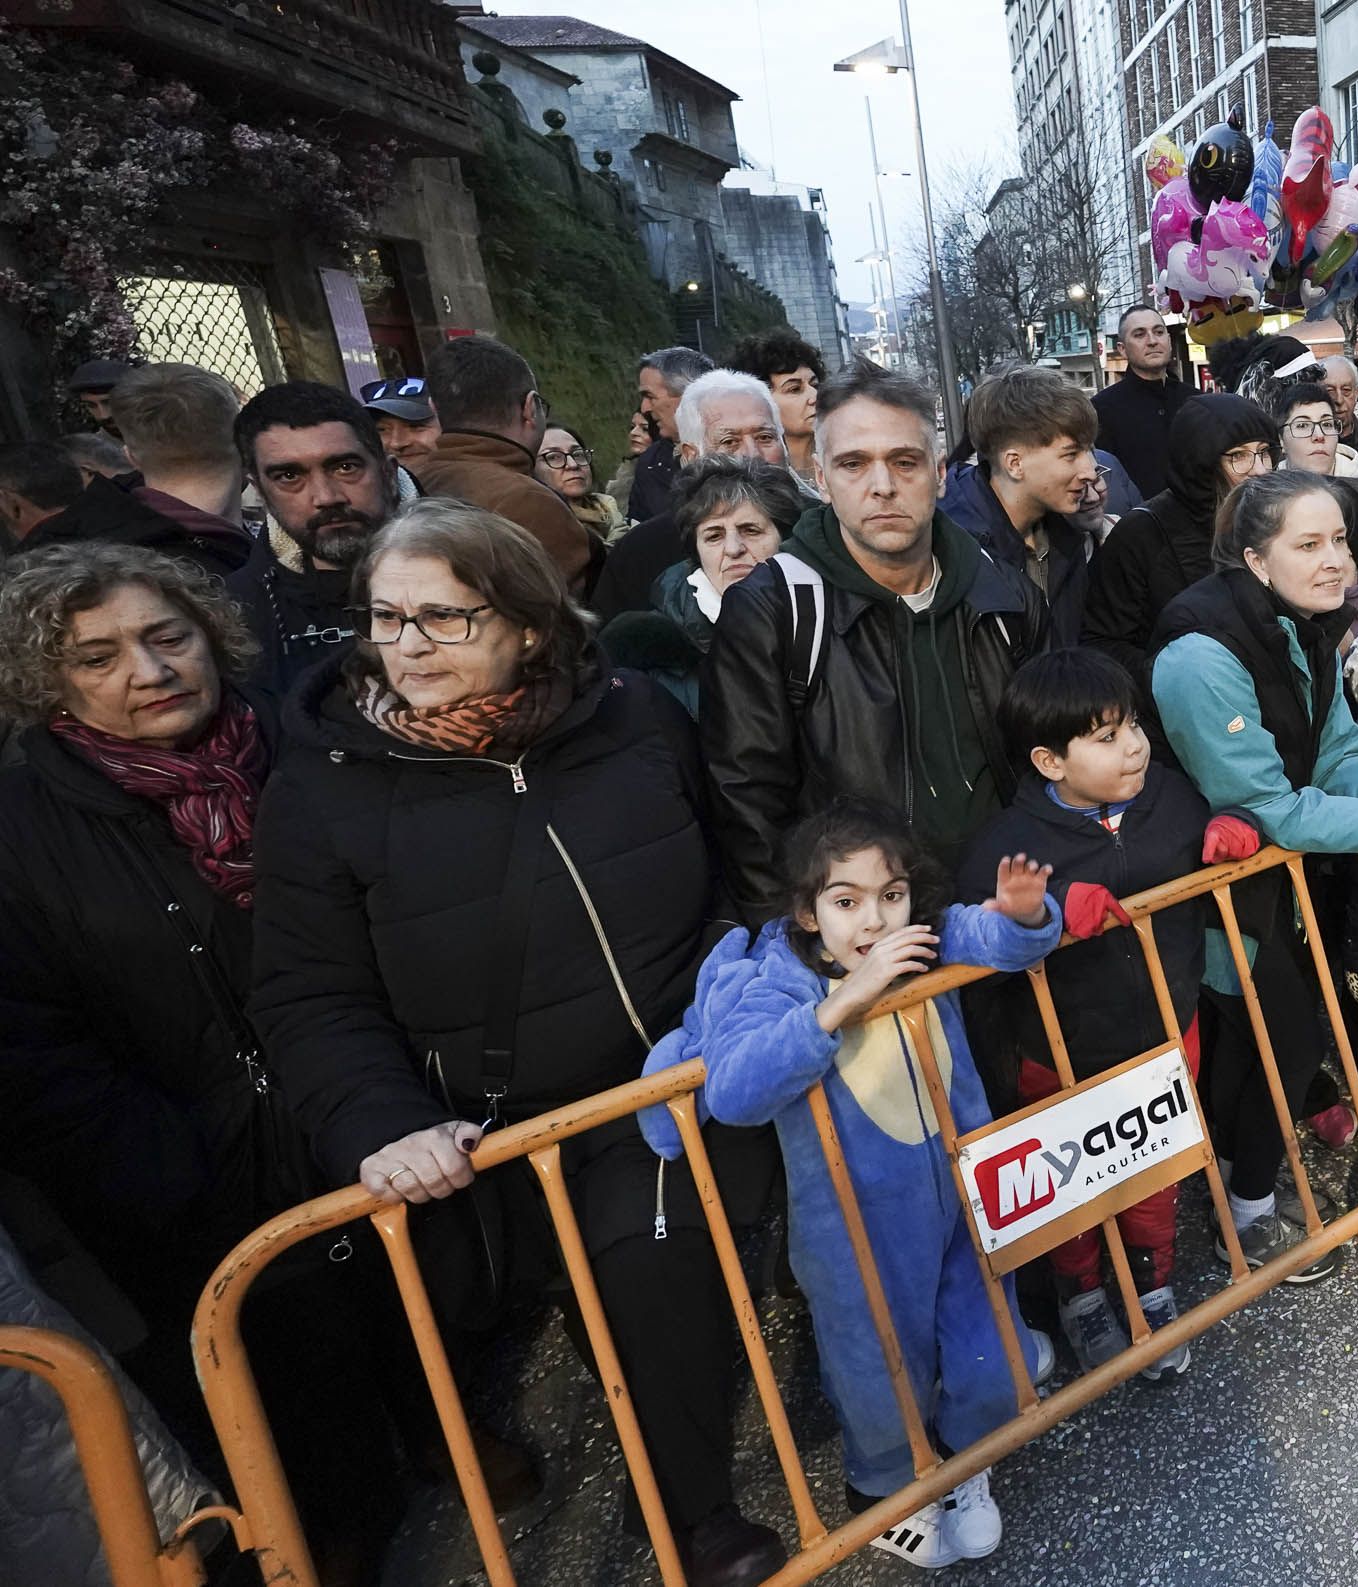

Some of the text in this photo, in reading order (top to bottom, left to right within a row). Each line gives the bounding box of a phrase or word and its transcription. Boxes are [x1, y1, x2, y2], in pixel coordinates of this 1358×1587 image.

[443, 295, 452, 313] 3
[994, 1078, 1189, 1220] Myagal
[1085, 1137, 1170, 1186] ALQUILER
